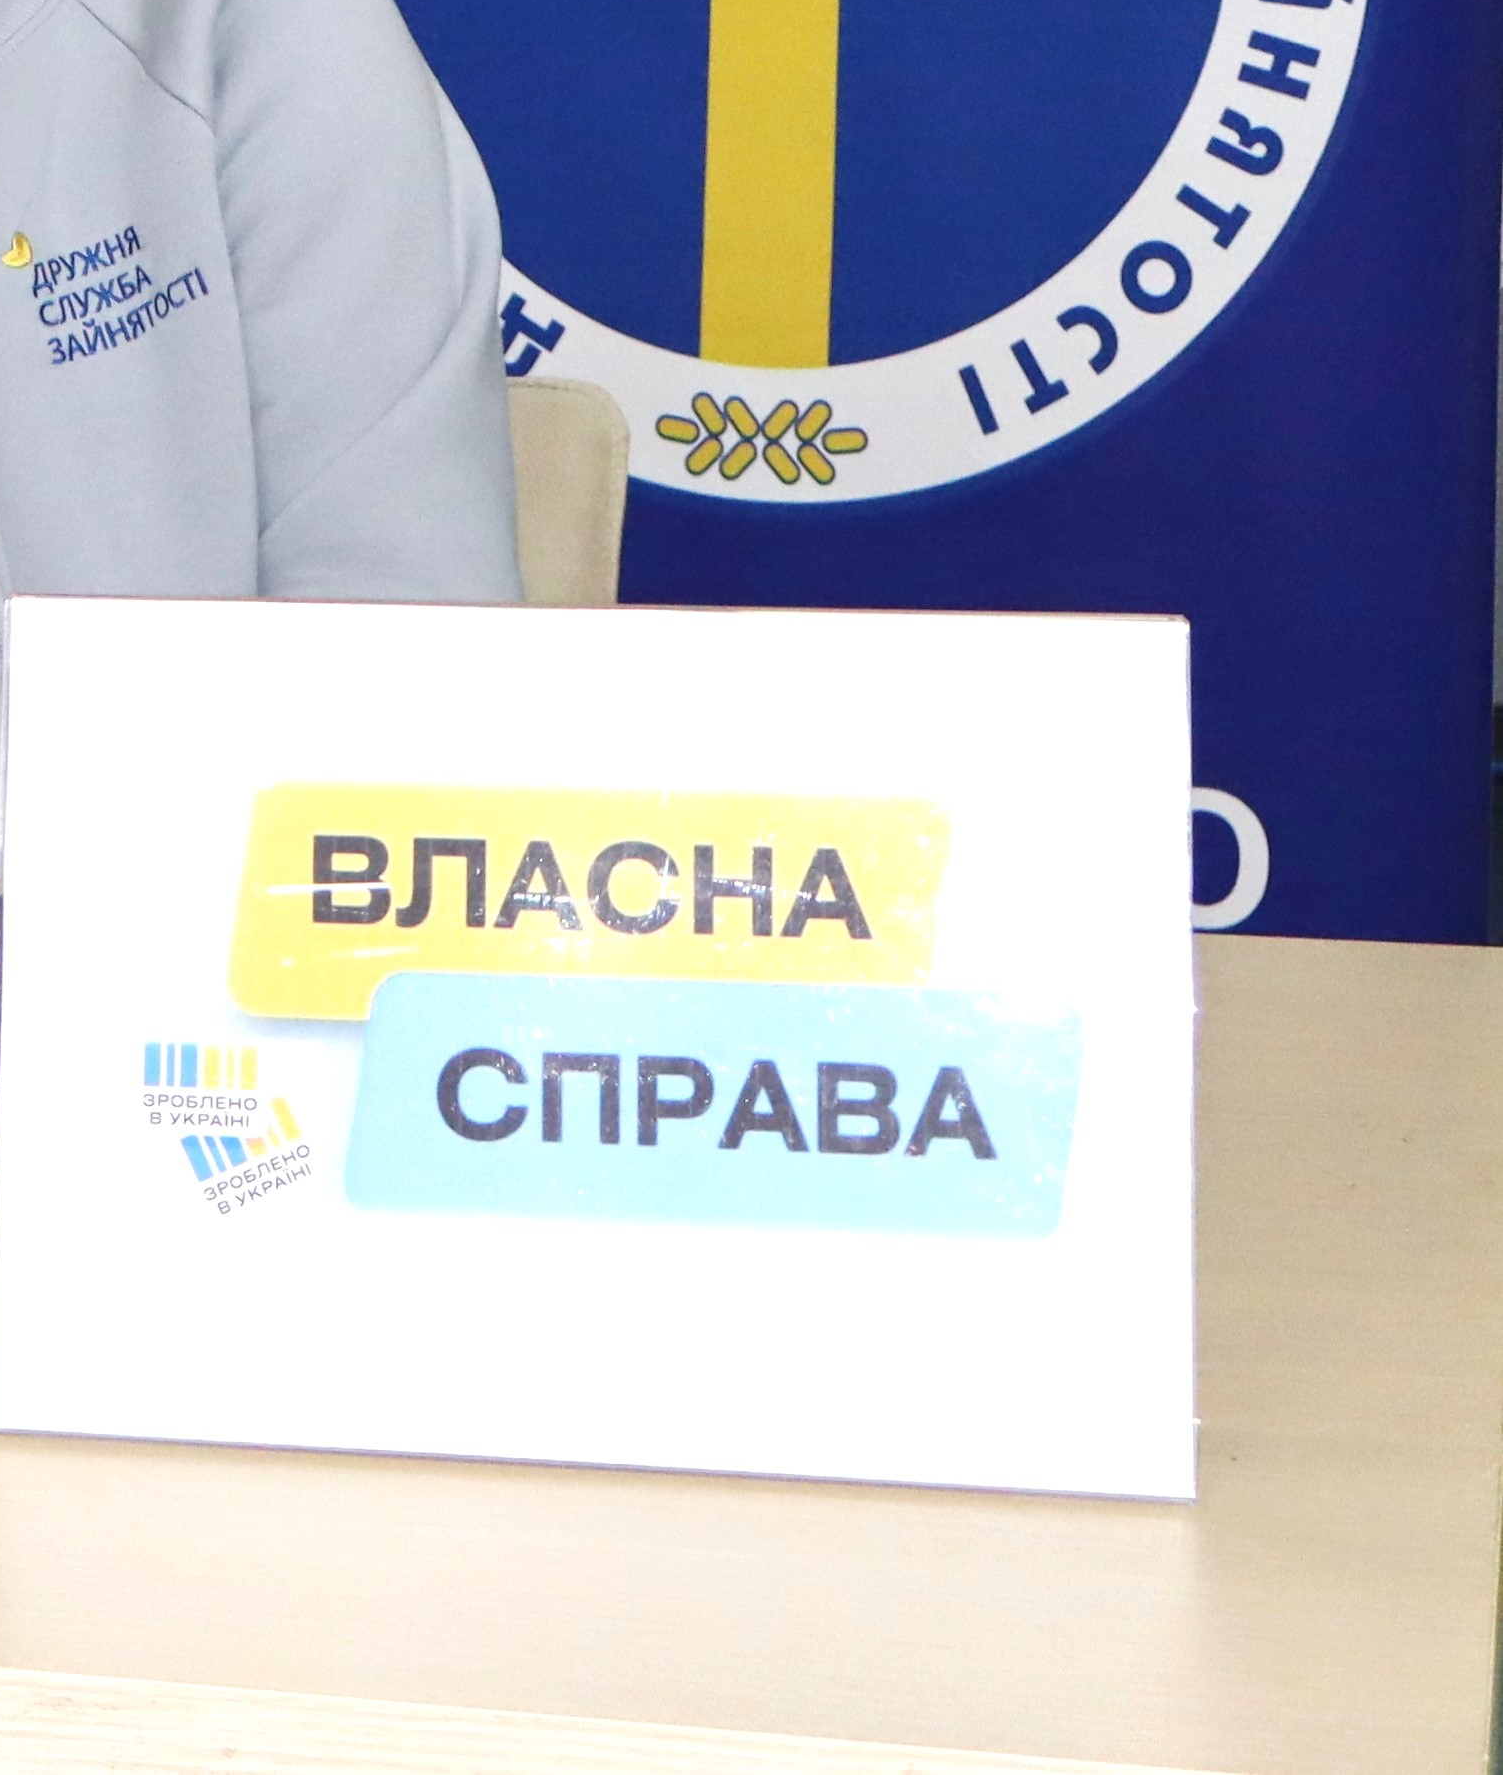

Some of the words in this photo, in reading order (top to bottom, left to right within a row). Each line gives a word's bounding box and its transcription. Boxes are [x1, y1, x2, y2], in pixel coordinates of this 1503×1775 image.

[32, 226, 141, 298] ДРУЖНЯ
[39, 264, 153, 327] СЛУЖБА
[48, 267, 209, 365] ЗАЙНЯТОСТІ
[311, 834, 873, 940] ВЛАСНА
[142, 1093, 258, 1112] ЗРОБЛЕНО
[149, 1111, 162, 1125] В
[170, 1111, 250, 1128] УКРАЇНІ
[436, 1047, 998, 1160] СПРАВА
[203, 1144, 311, 1202] ЗРОБЛЕНО
[216, 1200, 232, 1215] В
[235, 1163, 312, 1207] УКРАЇНІ
